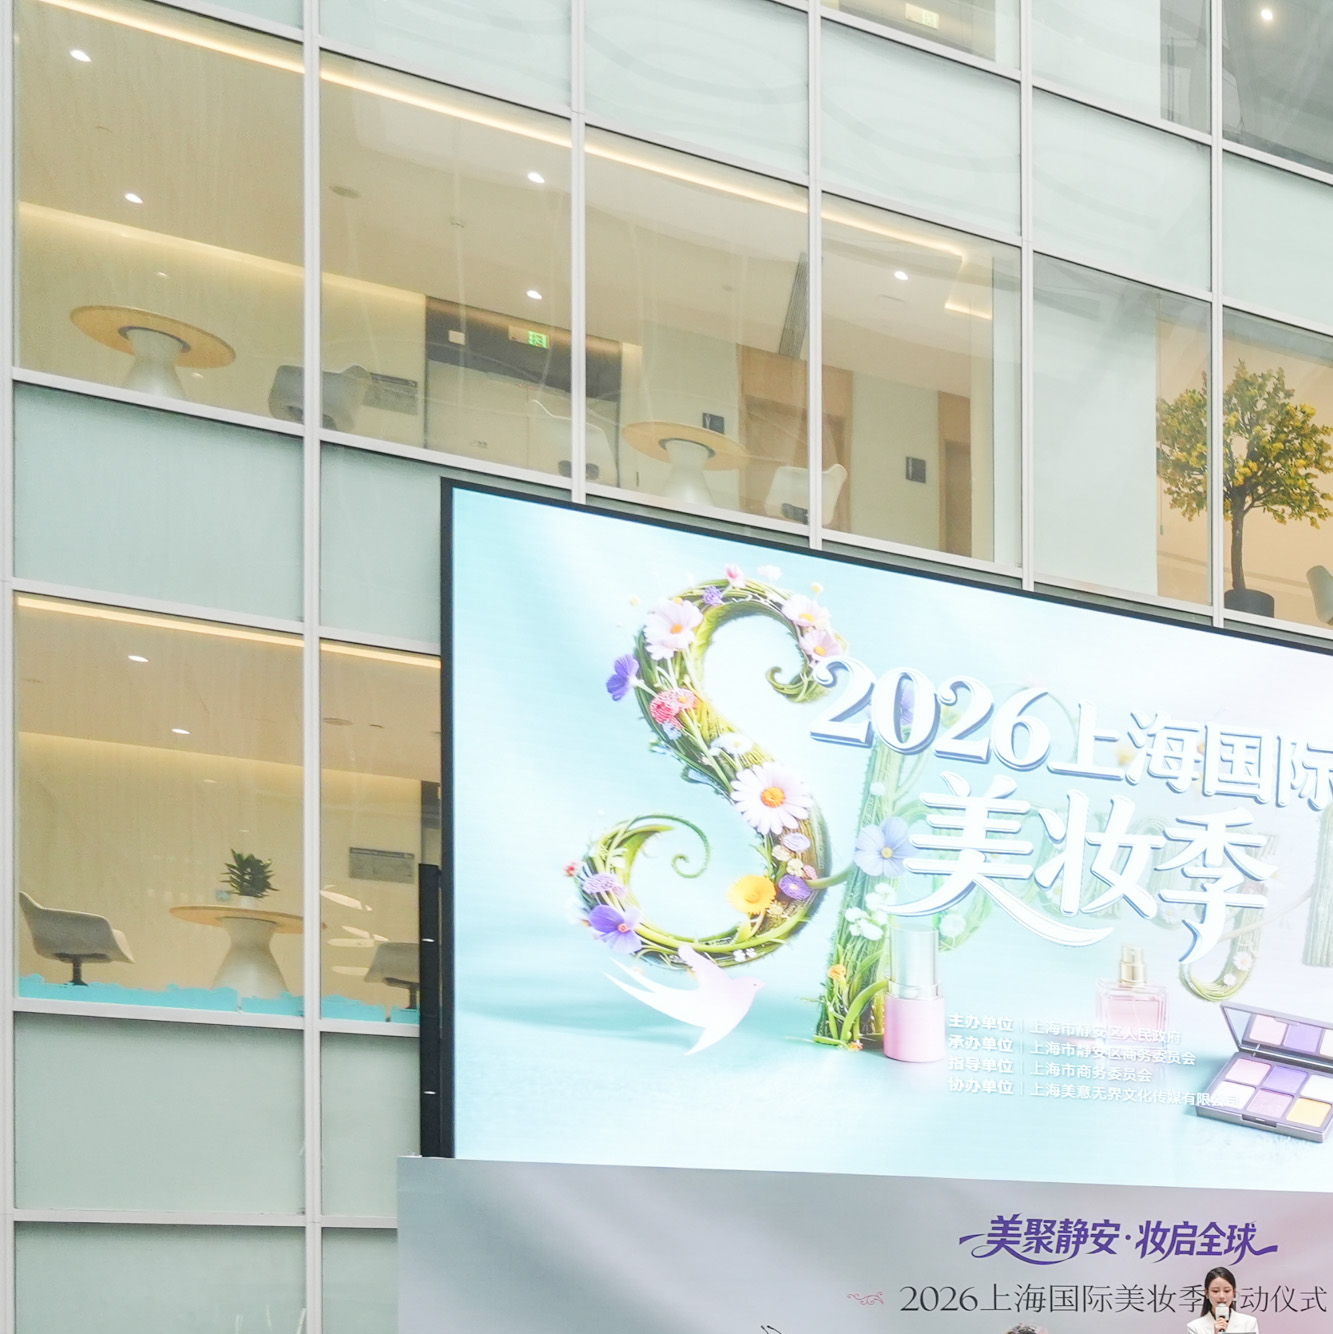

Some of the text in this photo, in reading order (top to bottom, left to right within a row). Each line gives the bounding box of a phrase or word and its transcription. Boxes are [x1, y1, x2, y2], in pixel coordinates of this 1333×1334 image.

[882, 770, 1280, 966] 美妆季
[948, 1013, 1182, 1045] 主办单位 上海市静安区人民政府
[948, 1034, 1197, 1066] 承办单位 上海市静安区商务委员会
[948, 1056, 1153, 1083] 指导单位 上海市商务委员会
[949, 1077, 1014, 1095] 协办单位
[959, 1213, 1278, 1266] 美聚静安·妆启全球
[899, 1283, 1328, 1314] 2026上海国际美妆季动仪式
